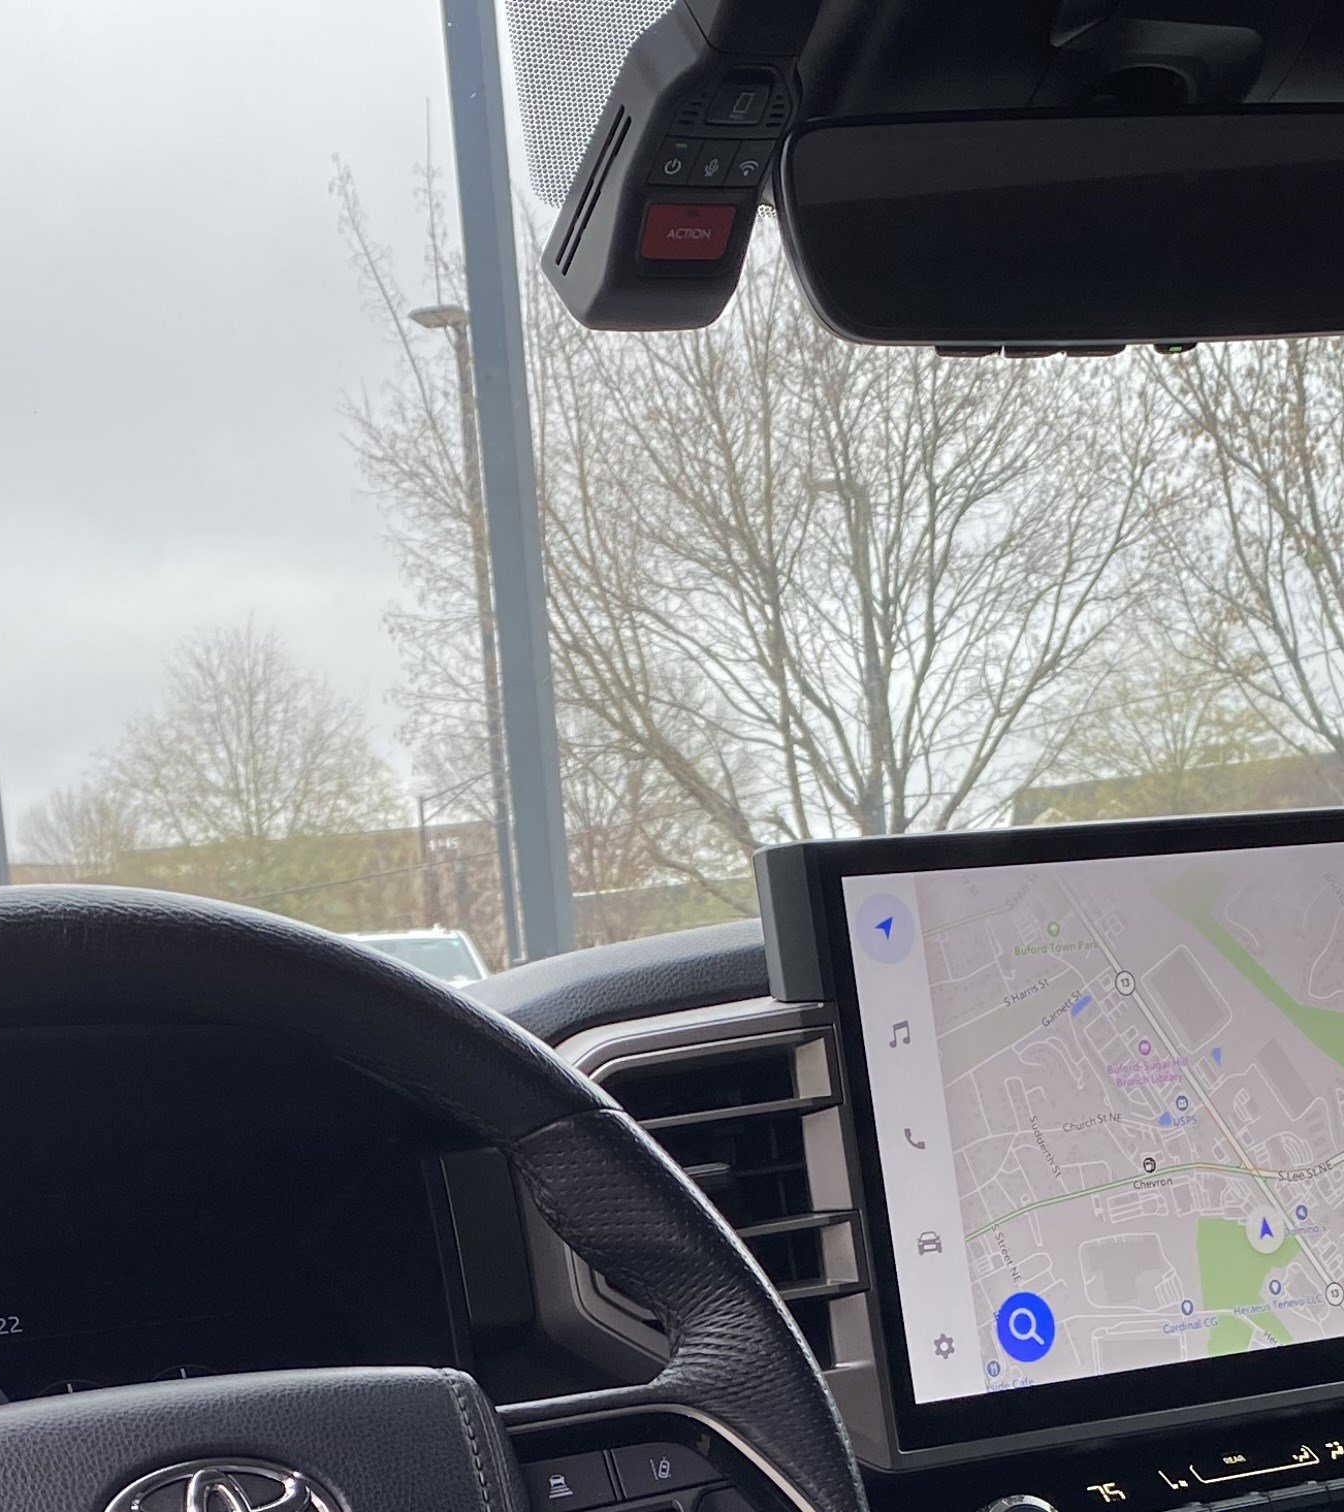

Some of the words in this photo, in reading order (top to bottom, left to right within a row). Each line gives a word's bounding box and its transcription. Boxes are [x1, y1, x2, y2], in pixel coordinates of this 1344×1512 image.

[666, 228, 711, 240] ACTION
[1014, 942, 1048, 956] Buford
[1050, 943, 1077, 953] Town
[1077, 940, 1100, 952] Park
[1119, 977, 1131, 988] 13
[1003, 997, 1012, 1008] S
[1011, 983, 1039, 1005] Harris
[1038, 977, 1051, 990] St
[1041, 997, 1074, 1028] Garnett
[1071, 989, 1083, 1003] St
[1172, 1056, 1189, 1069] Hill
[1116, 1075, 1150, 1088] Branch
[1151, 1073, 1183, 1088] Library
[1062, 1117, 1097, 1133] Church
[1096, 1113, 1108, 1125] St
[1109, 1112, 1123, 1124] NE
[1173, 1115, 1198, 1128] USPS
[1029, 1115, 1057, 1167] Sudderth
[1052, 1164, 1062, 1179] St
[1278, 1170, 1286, 1182] S
[1286, 1170, 1306, 1183] Lee
[1306, 1167, 1318, 1179] St
[1316, 1160, 1334, 1175] NE
[1132, 1177, 1174, 1190] Chevron
[991, 1222, 1000, 1233] S
[994, 1232, 1015, 1268] Street
[1009, 1266, 1023, 1283] NE
[1162, 1319, 1202, 1335] Cardinal
[1203, 1316, 1219, 1329] CG
[1222, 1453, 1247, 1465] REAR
[1086, 1481, 1127, 1504] 75
